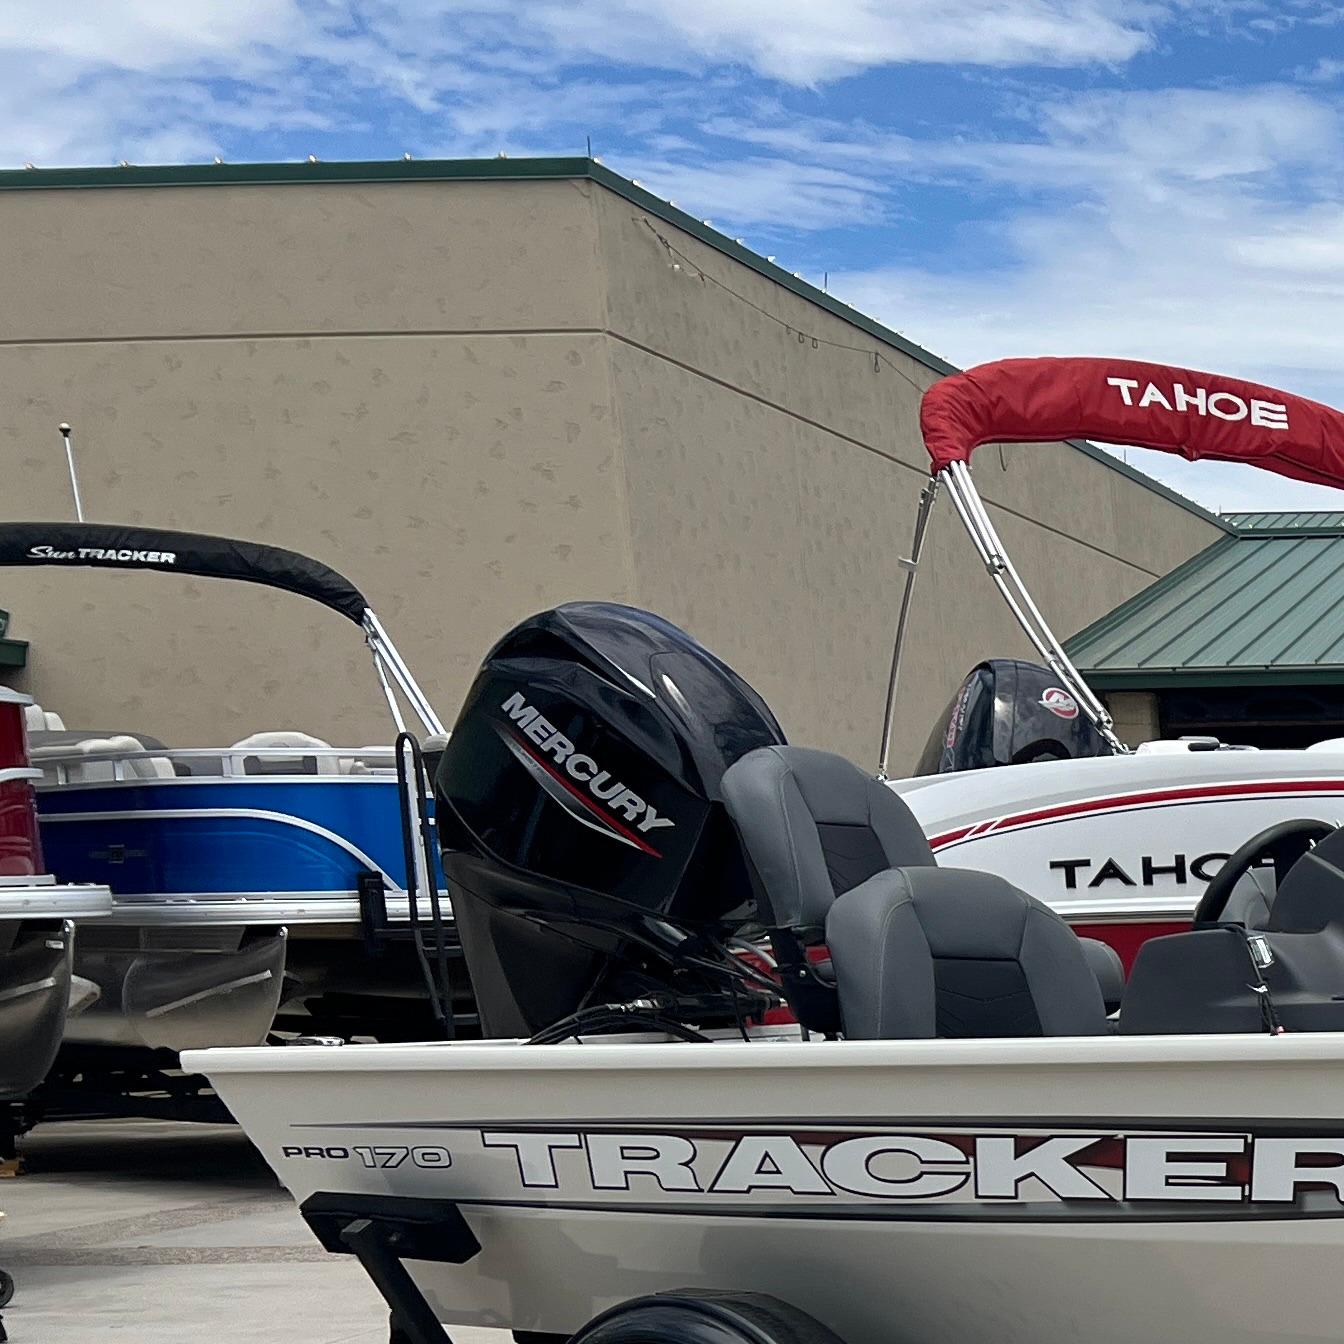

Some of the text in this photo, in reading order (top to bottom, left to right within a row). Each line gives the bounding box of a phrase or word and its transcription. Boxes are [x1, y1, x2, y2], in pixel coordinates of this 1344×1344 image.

[1107, 377, 1289, 430] TAHOE
[26, 545, 176, 564] Sun TRACKER
[501, 691, 675, 833] MERCURY
[282, 1146, 349, 1160] PRO
[354, 1145, 452, 1169] 170
